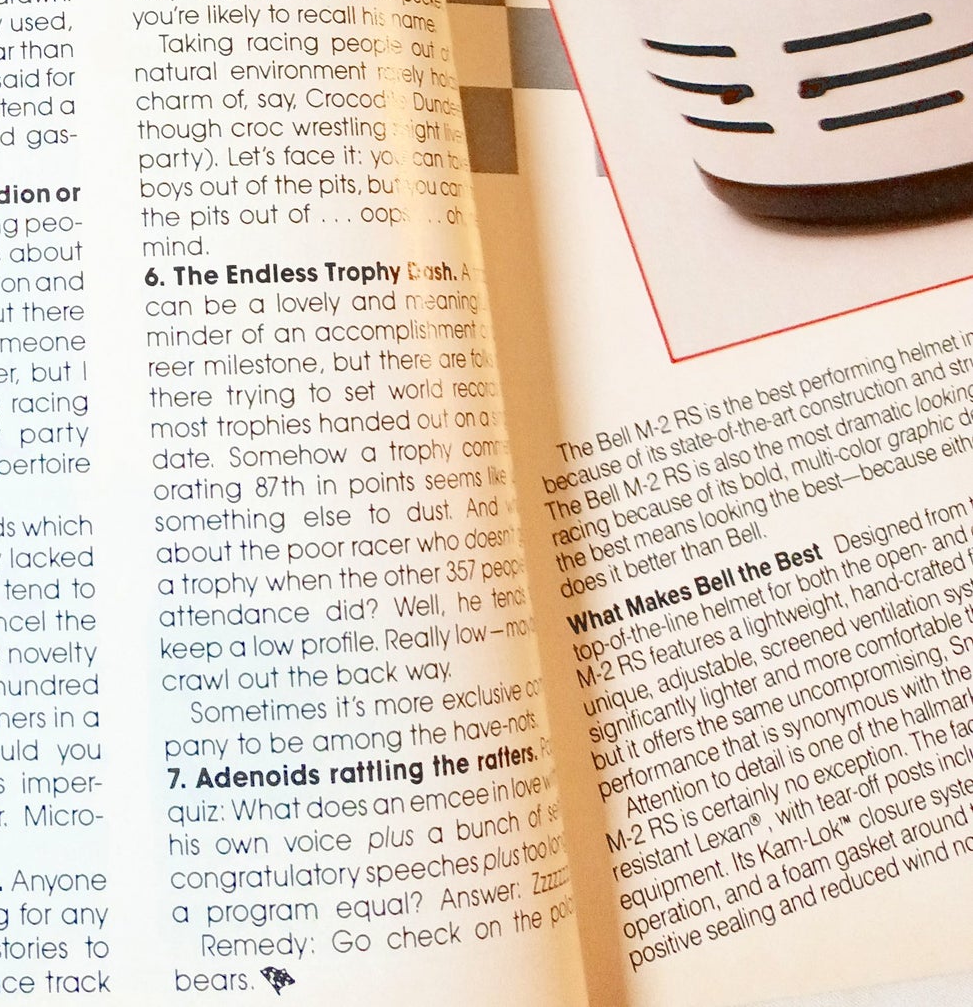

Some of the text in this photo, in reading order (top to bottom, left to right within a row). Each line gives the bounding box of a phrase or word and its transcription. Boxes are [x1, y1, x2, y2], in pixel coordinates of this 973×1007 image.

[145, 261, 400, 287] 6. The Endless Trophy
[154, 478, 241, 504] orating
[255, 475, 305, 498] 87th
[317, 474, 337, 495] in
[349, 471, 415, 499] points
[425, 471, 482, 490] seems
[560, 521, 767, 598] does it better than Bell.
[566, 543, 823, 635] What Makes Bell the Best
[25, 804, 104, 827] Micro-
[11, 870, 106, 896] Anyone
[629, 843, 950, 972] positive sealing and reduced wind
[84, 936, 109, 959] to
[202, 909, 542, 960] Remedy: Go check on the
[175, 969, 254, 992] bears.
